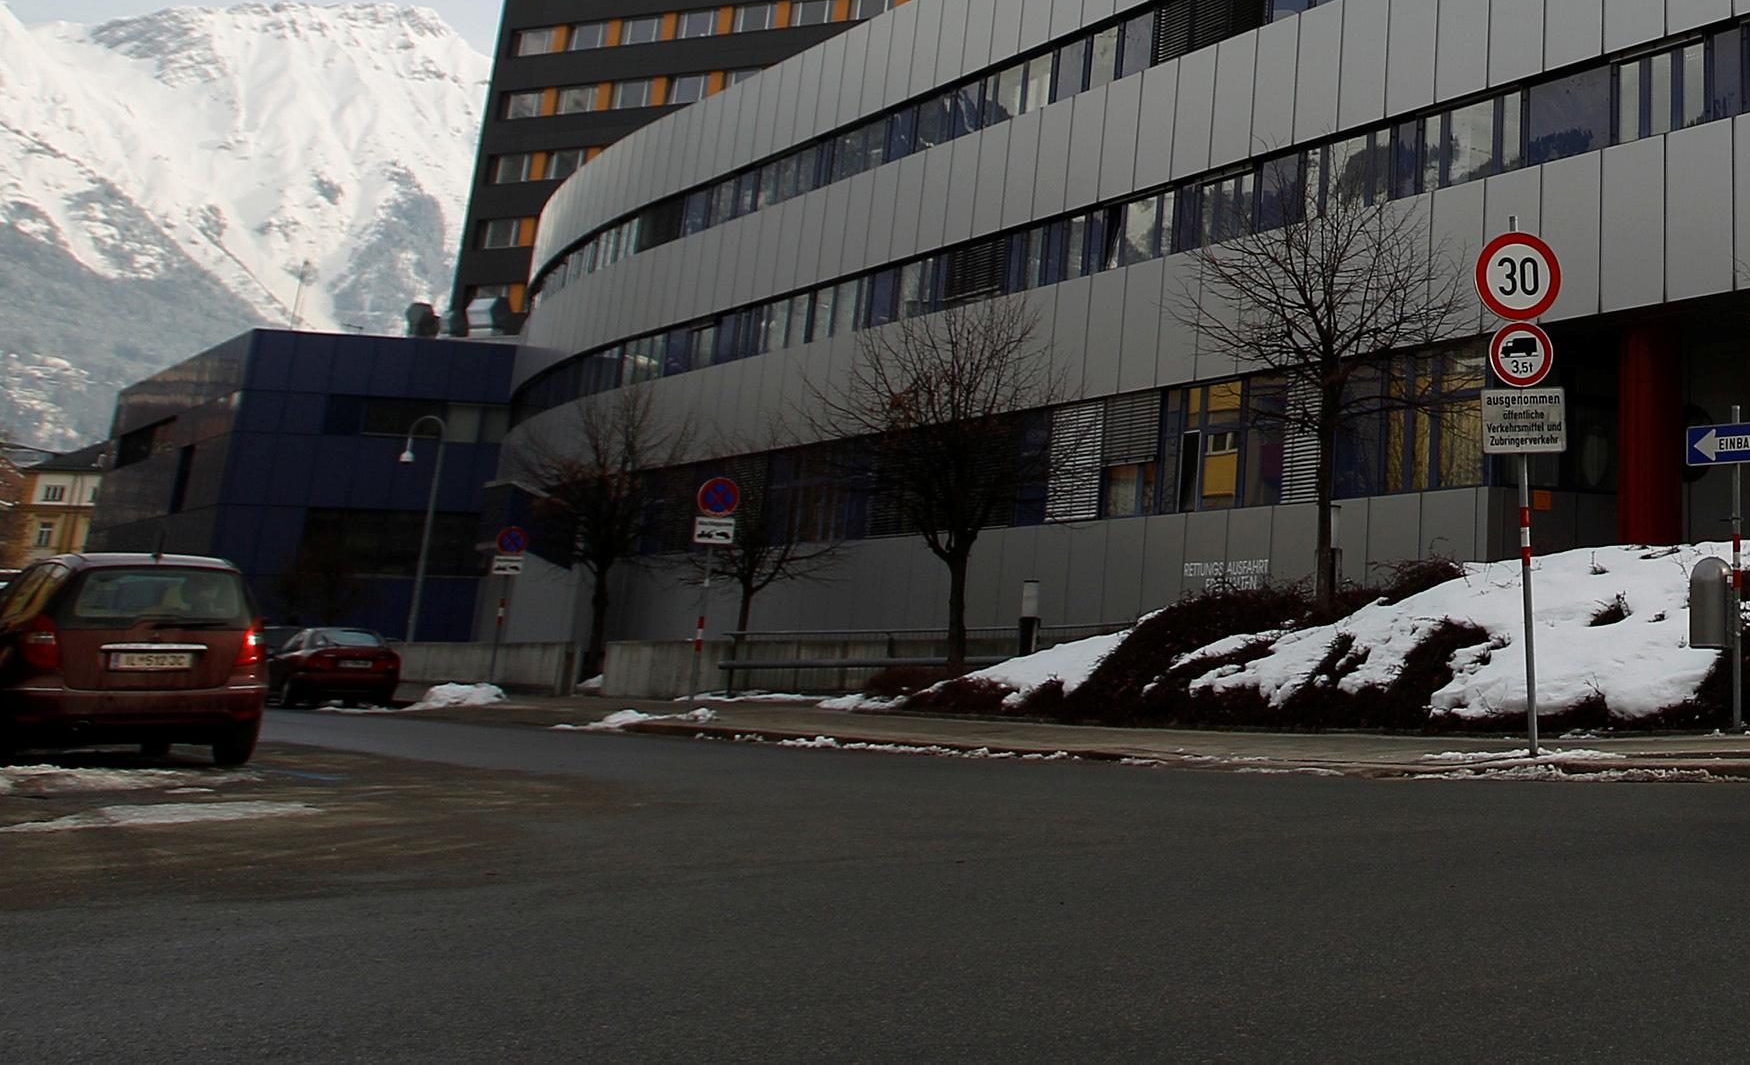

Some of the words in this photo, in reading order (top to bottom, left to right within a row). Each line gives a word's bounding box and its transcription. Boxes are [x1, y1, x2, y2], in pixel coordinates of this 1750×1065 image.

[1498, 257, 1539, 296] 30
[1510, 359, 1534, 375] 3,5t
[1486, 394, 1560, 409] ausgenommen
[1503, 409, 1545, 420] öffentliche
[1486, 422, 1545, 433] Verkehrsmittel
[1547, 421, 1562, 432] und
[1489, 434, 1559, 447] Zubringerverkehr
[1183, 561, 1225, 576] RETTUNGS
[1226, 559, 1269, 575] AUSFAHRT
